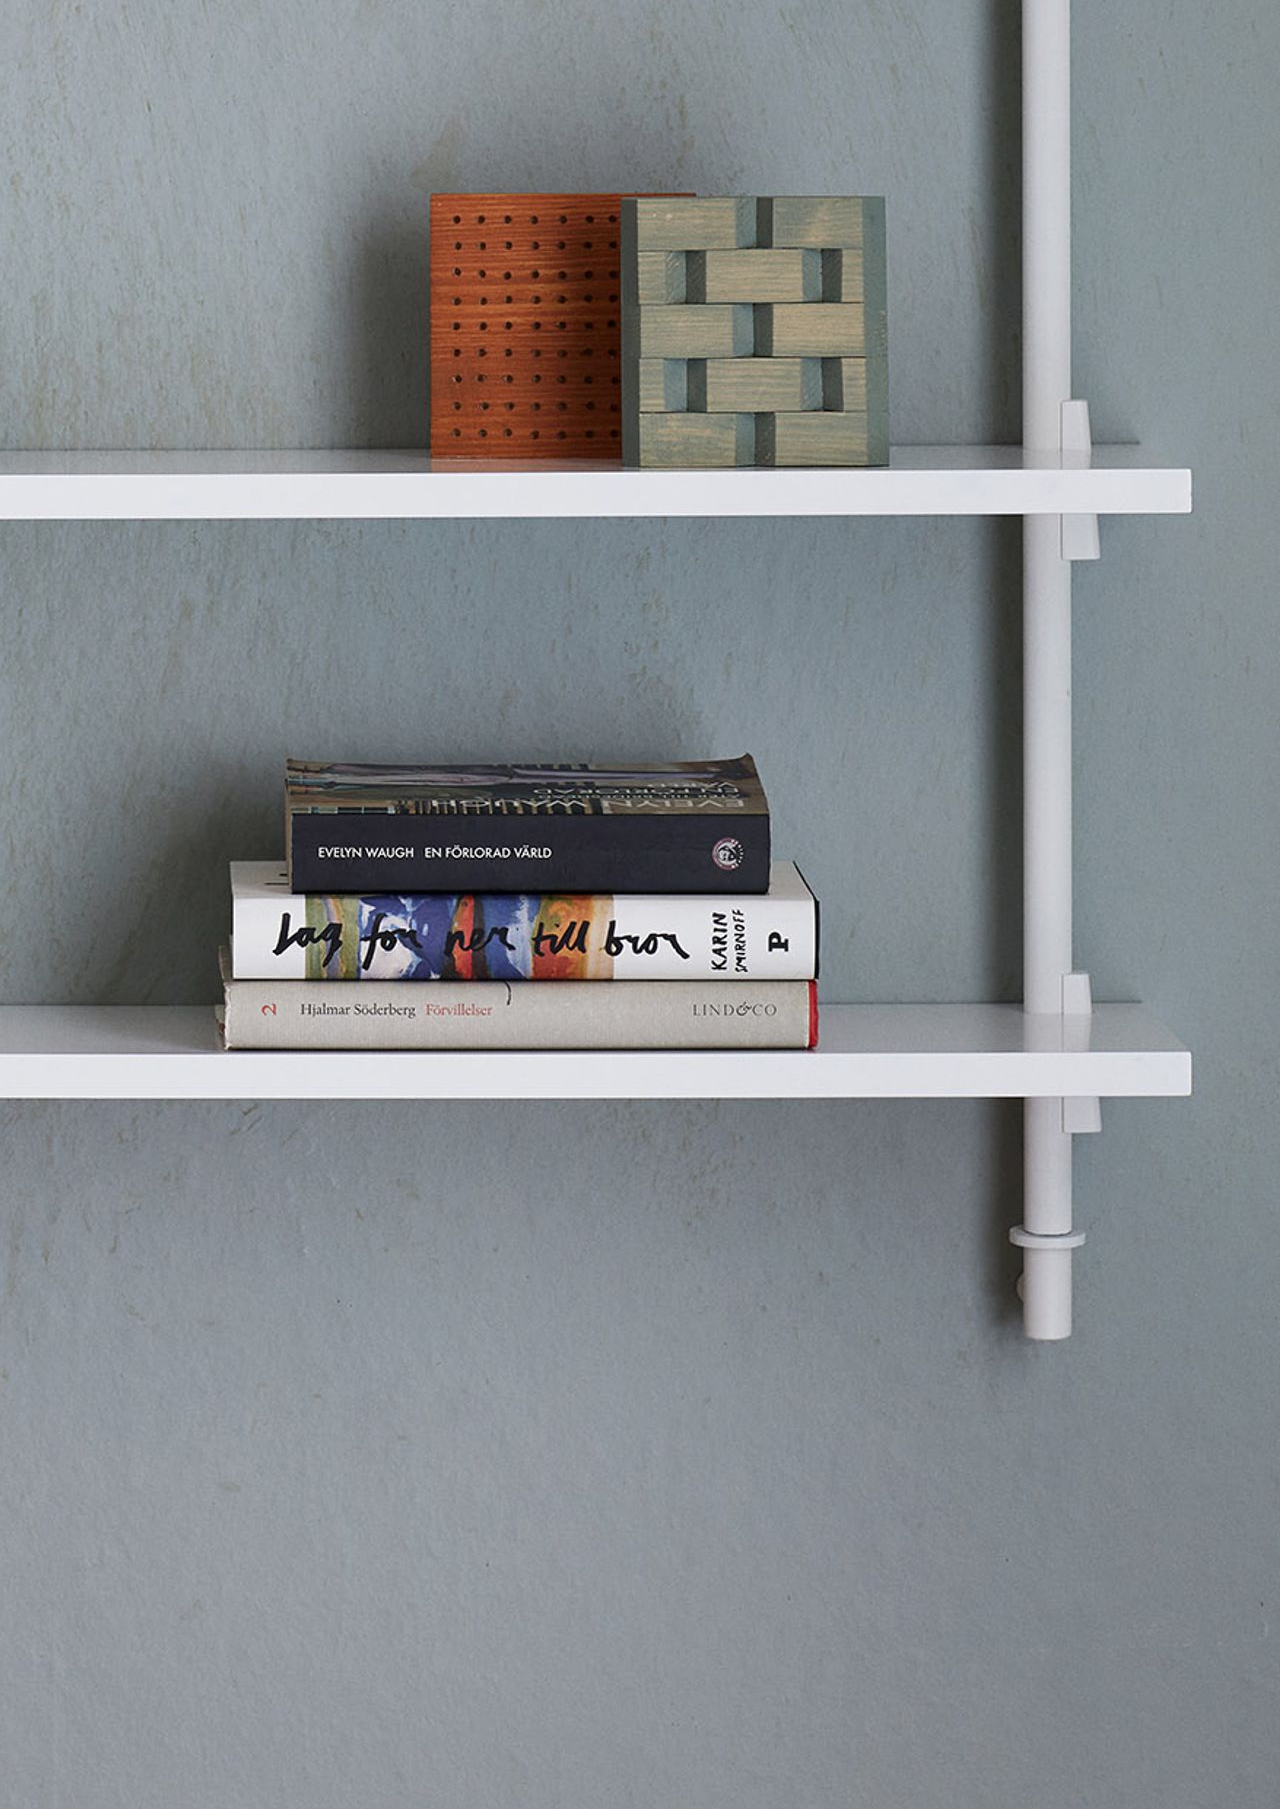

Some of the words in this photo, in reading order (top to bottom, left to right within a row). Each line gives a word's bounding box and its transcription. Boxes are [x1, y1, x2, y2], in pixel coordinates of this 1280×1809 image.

[318, 847, 362, 858] EVELYN
[365, 847, 414, 858] WAUGH
[425, 847, 442, 858] EN
[446, 845, 510, 858] FÖRLORAD
[514, 844, 552, 858] VÄRLD
[445, 926, 515, 955] ner
[531, 920, 590, 957] till
[604, 921, 690, 959] bror
[711, 912, 727, 970] KARIN
[732, 909, 748, 972] SMIRNOFF
[769, 931, 789, 952] P
[261, 1003, 277, 1016] 2
[300, 1003, 350, 1017] Hjalmar
[354, 1003, 416, 1018] Söderberg
[425, 1003, 492, 1016] Förvillelser
[693, 1002, 777, 1017] LIND&CO
